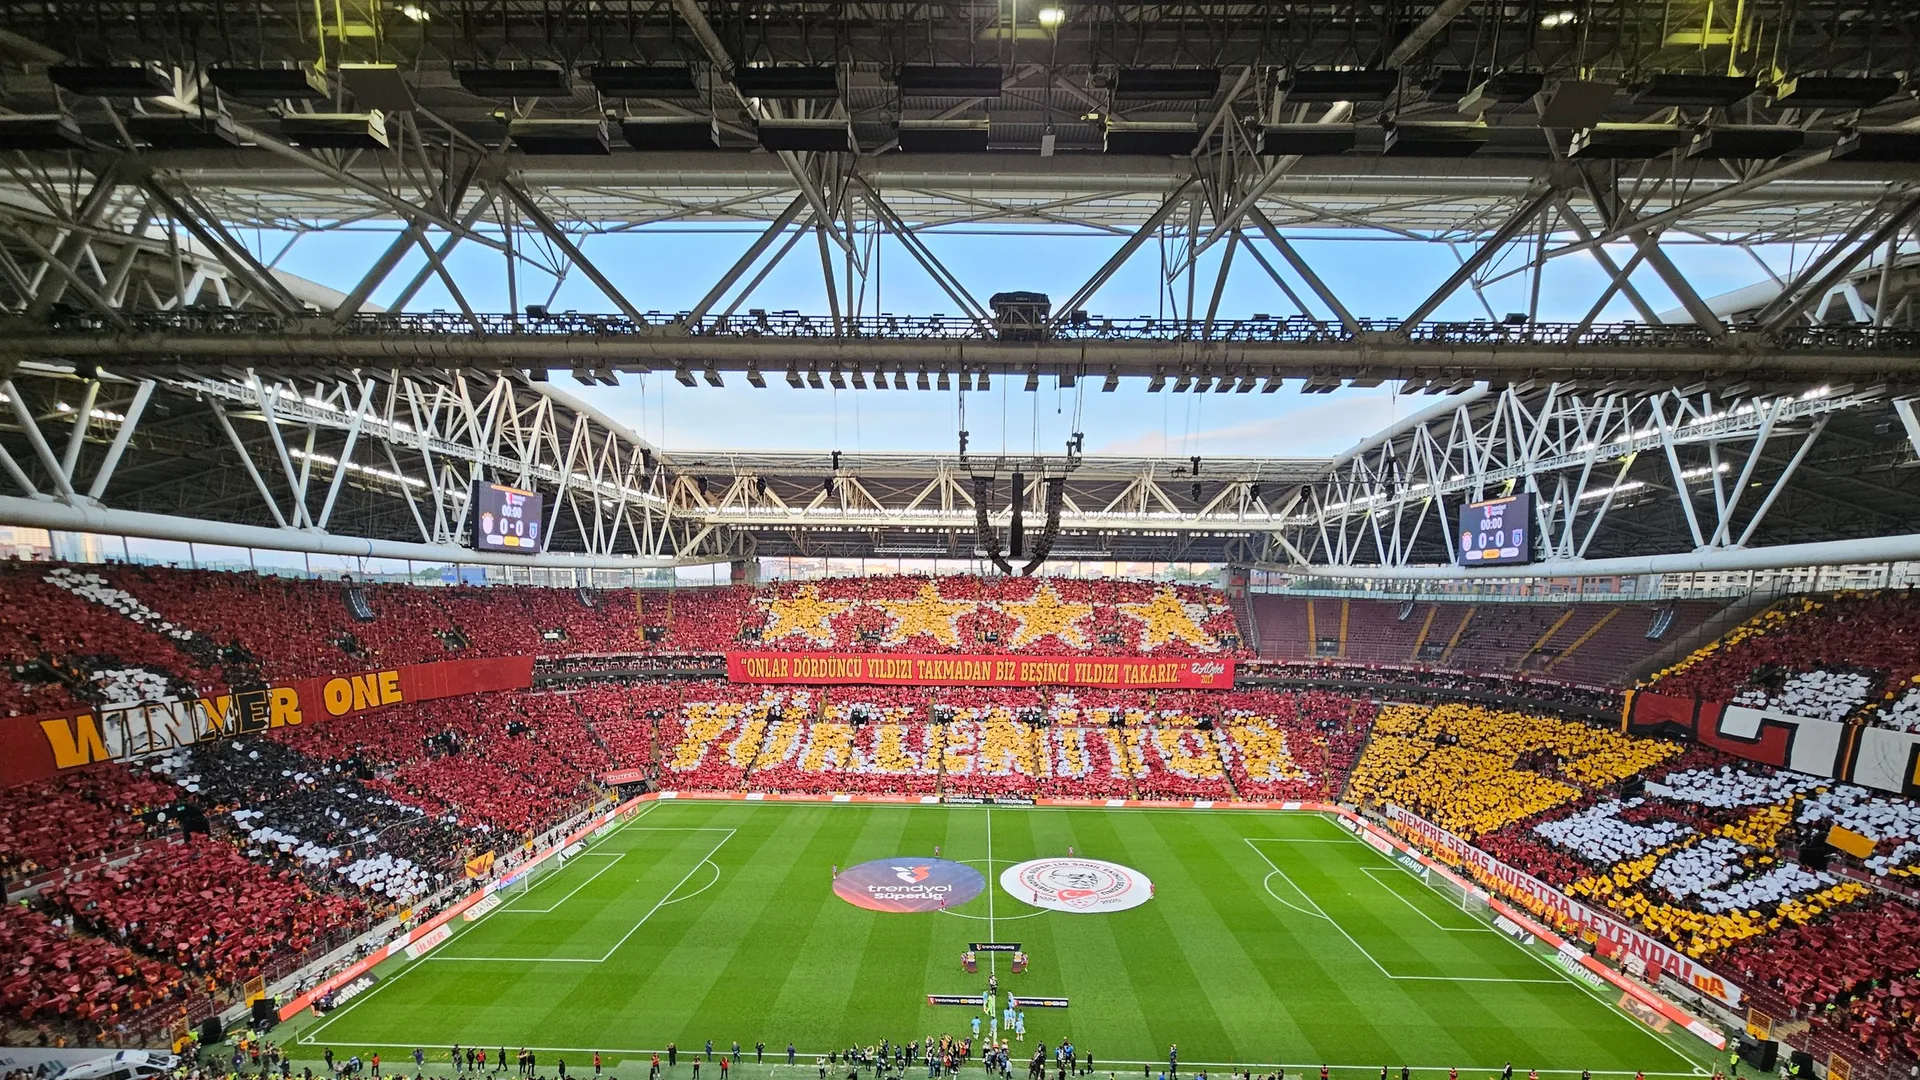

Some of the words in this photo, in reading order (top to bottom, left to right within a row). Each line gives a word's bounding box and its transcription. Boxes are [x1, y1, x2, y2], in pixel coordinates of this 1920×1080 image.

[502, 504, 522, 518] 00:00
[500, 518, 508, 534] 0
[516, 520, 524, 536] 0
[1480, 517, 1502, 530] 00:00
[1479, 532, 1487, 549] 0
[1496, 530, 1504, 548] 0
[793, 655, 862, 678] DÖRDÜNCÜ
[867, 659, 912, 679] YILDIZI
[917, 660, 991, 681] TAKMADAN
[996, 658, 1015, 681] BİZ
[1020, 660, 1069, 685] BEŞİNCİ
[1074, 663, 1119, 684] YILDIZI
[40, 686, 302, 770] WINNER
[323, 670, 403, 716] ONE
[1403, 855, 1424, 874] RAMS
[868, 885, 952, 894] trendyol
[1397, 811, 1444, 844] SIEMPRE
[1447, 834, 1490, 871] SERAS
[1494, 863, 1572, 919] NUESTRA
[1577, 907, 1692, 982] LEYENDA!
[1464, 859, 1568, 928] GALATASARAY
[416, 931, 445, 954] ÜLKER
[1557, 950, 1604, 987] Bilyoner
